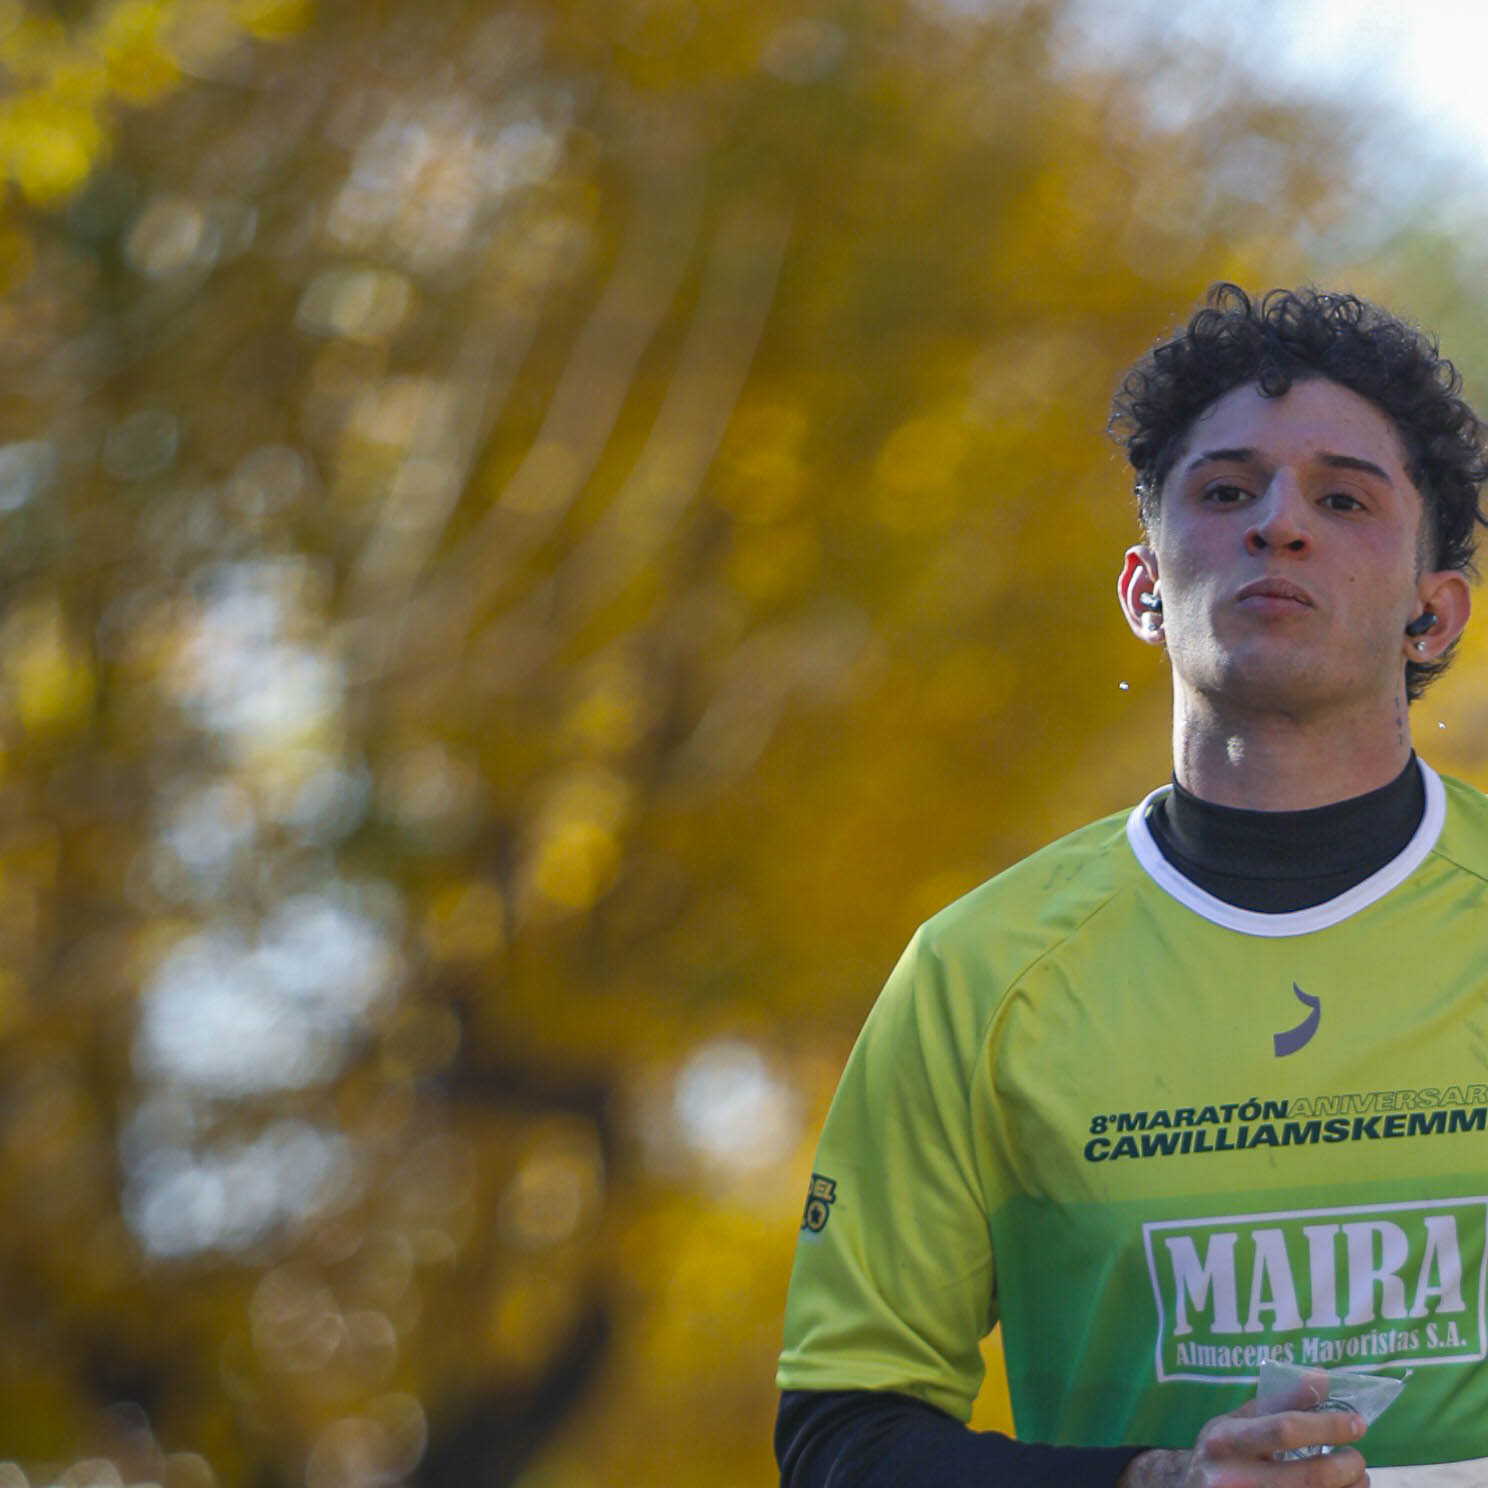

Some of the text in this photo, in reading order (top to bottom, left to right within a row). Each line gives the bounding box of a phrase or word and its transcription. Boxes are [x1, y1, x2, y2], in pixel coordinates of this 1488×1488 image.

[1165, 1215, 1467, 1335] MAIRA
[1176, 1321, 1468, 1368] Almacenes Mayoristas S.A.
